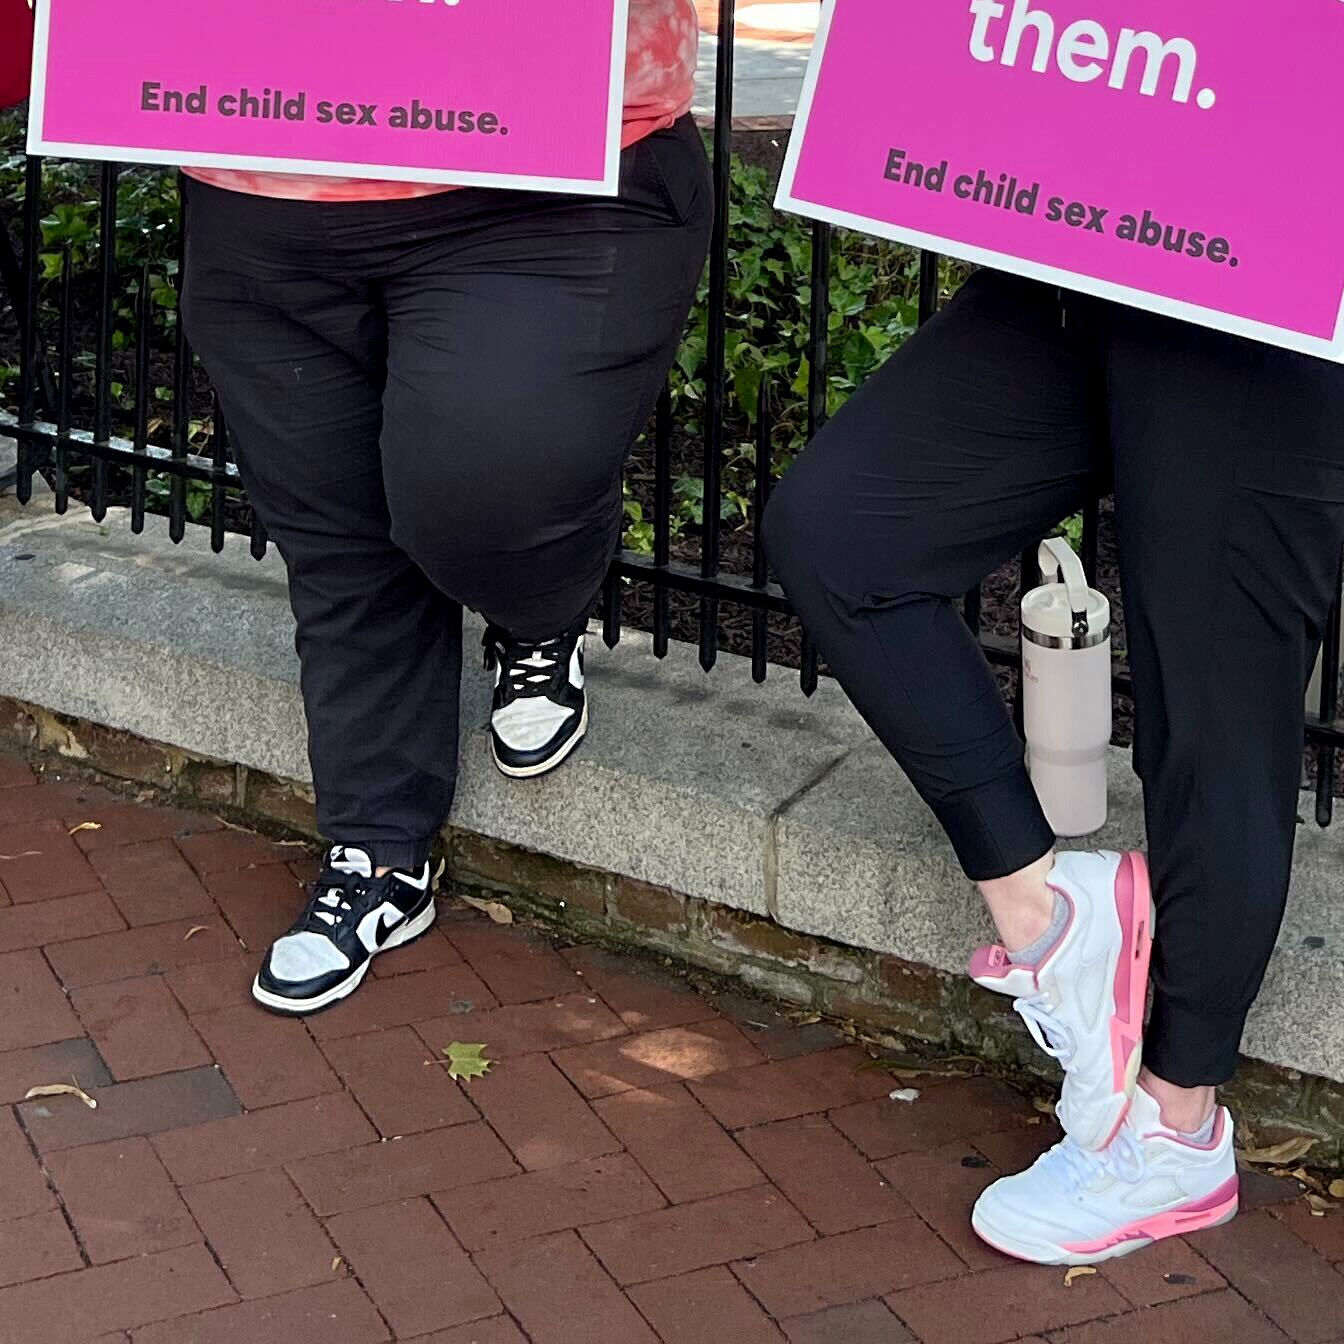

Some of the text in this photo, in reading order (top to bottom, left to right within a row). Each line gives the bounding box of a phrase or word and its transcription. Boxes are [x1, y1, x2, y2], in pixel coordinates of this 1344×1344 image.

[141, 80, 509, 136] End child sex abuse.
[883, 147, 1240, 268] End child sex abuse.
